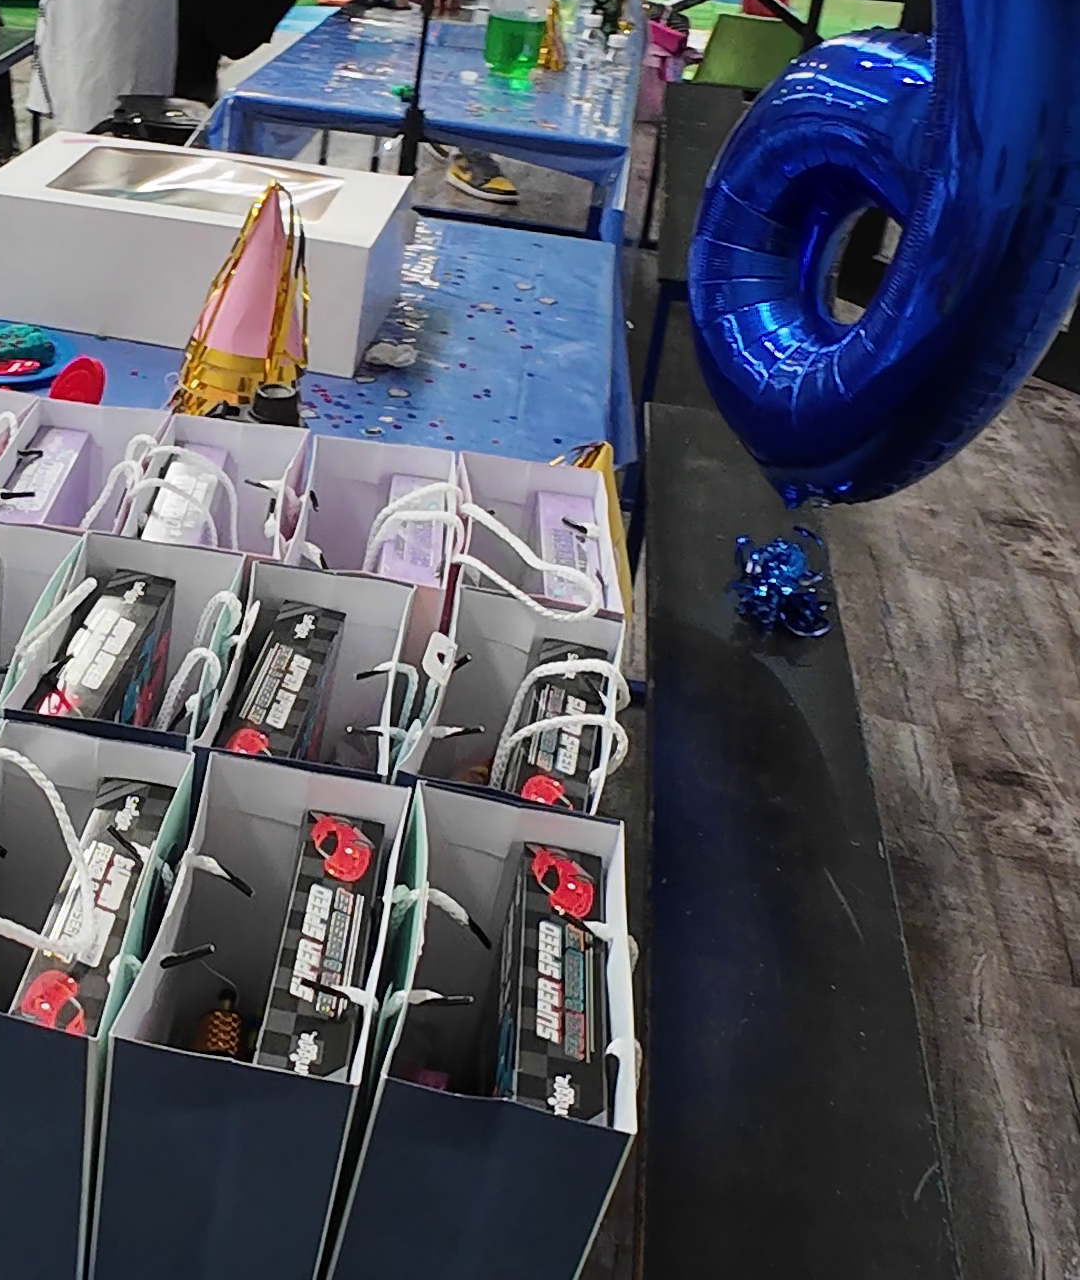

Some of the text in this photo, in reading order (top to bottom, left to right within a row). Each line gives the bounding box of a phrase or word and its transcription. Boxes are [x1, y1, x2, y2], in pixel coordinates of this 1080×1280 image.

[301, 883, 334, 941] SPEED
[534, 921, 563, 1044] SUPER SPEED
[289, 1031, 318, 1074] miggle
[547, 1075, 574, 1116] miggle
